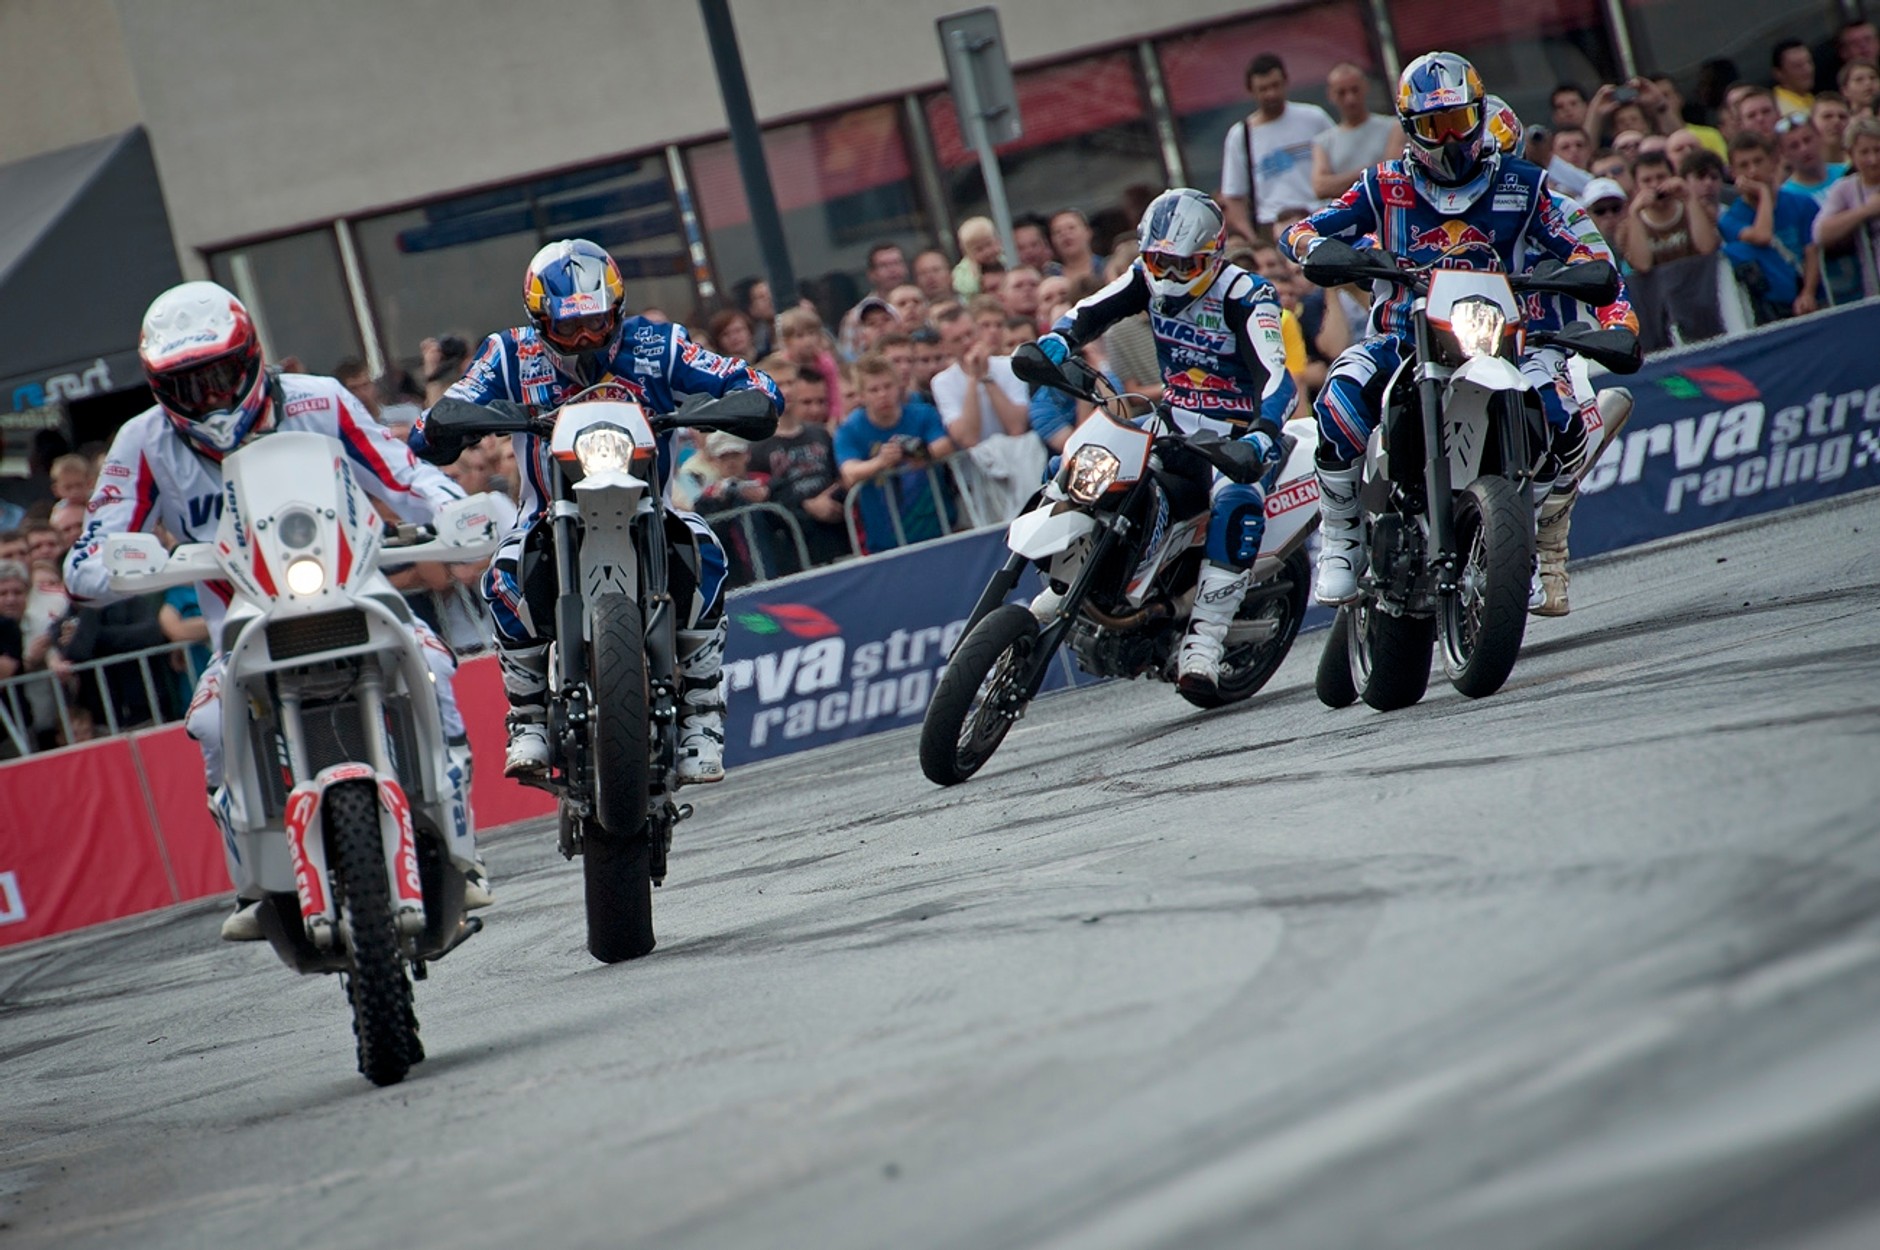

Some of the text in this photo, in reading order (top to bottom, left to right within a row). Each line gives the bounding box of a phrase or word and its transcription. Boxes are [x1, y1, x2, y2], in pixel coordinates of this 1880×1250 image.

[1152, 316, 1228, 352] MRW
[288, 399, 328, 414] ORLEN
[1202, 393, 1253, 411] Bull
[1268, 482, 1319, 513] ORLEN
[1664, 434, 1854, 514] racing
[225, 480, 247, 547] verva
[751, 670, 932, 748] racing
[286, 826, 312, 910] ORLEN
[401, 808, 421, 893] ORLEN
